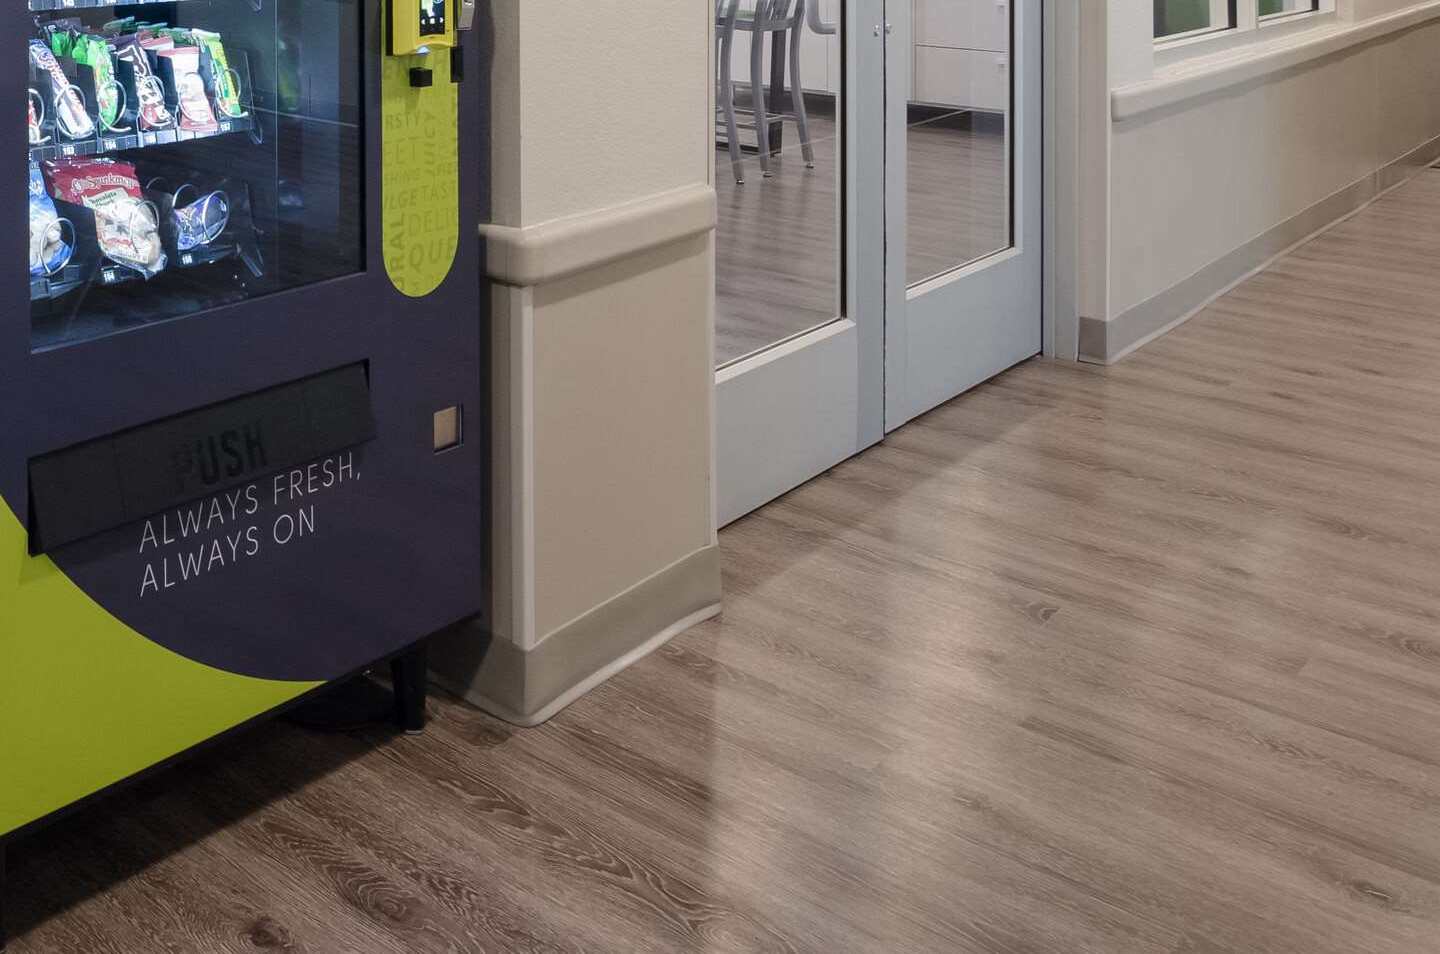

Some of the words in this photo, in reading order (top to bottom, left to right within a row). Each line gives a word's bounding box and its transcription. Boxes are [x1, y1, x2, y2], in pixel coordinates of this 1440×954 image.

[140, 484, 259, 553] ALWAYS
[273, 451, 361, 505] FRESH,
[140, 526, 259, 597] ALWAYS
[273, 505, 315, 545] ON
